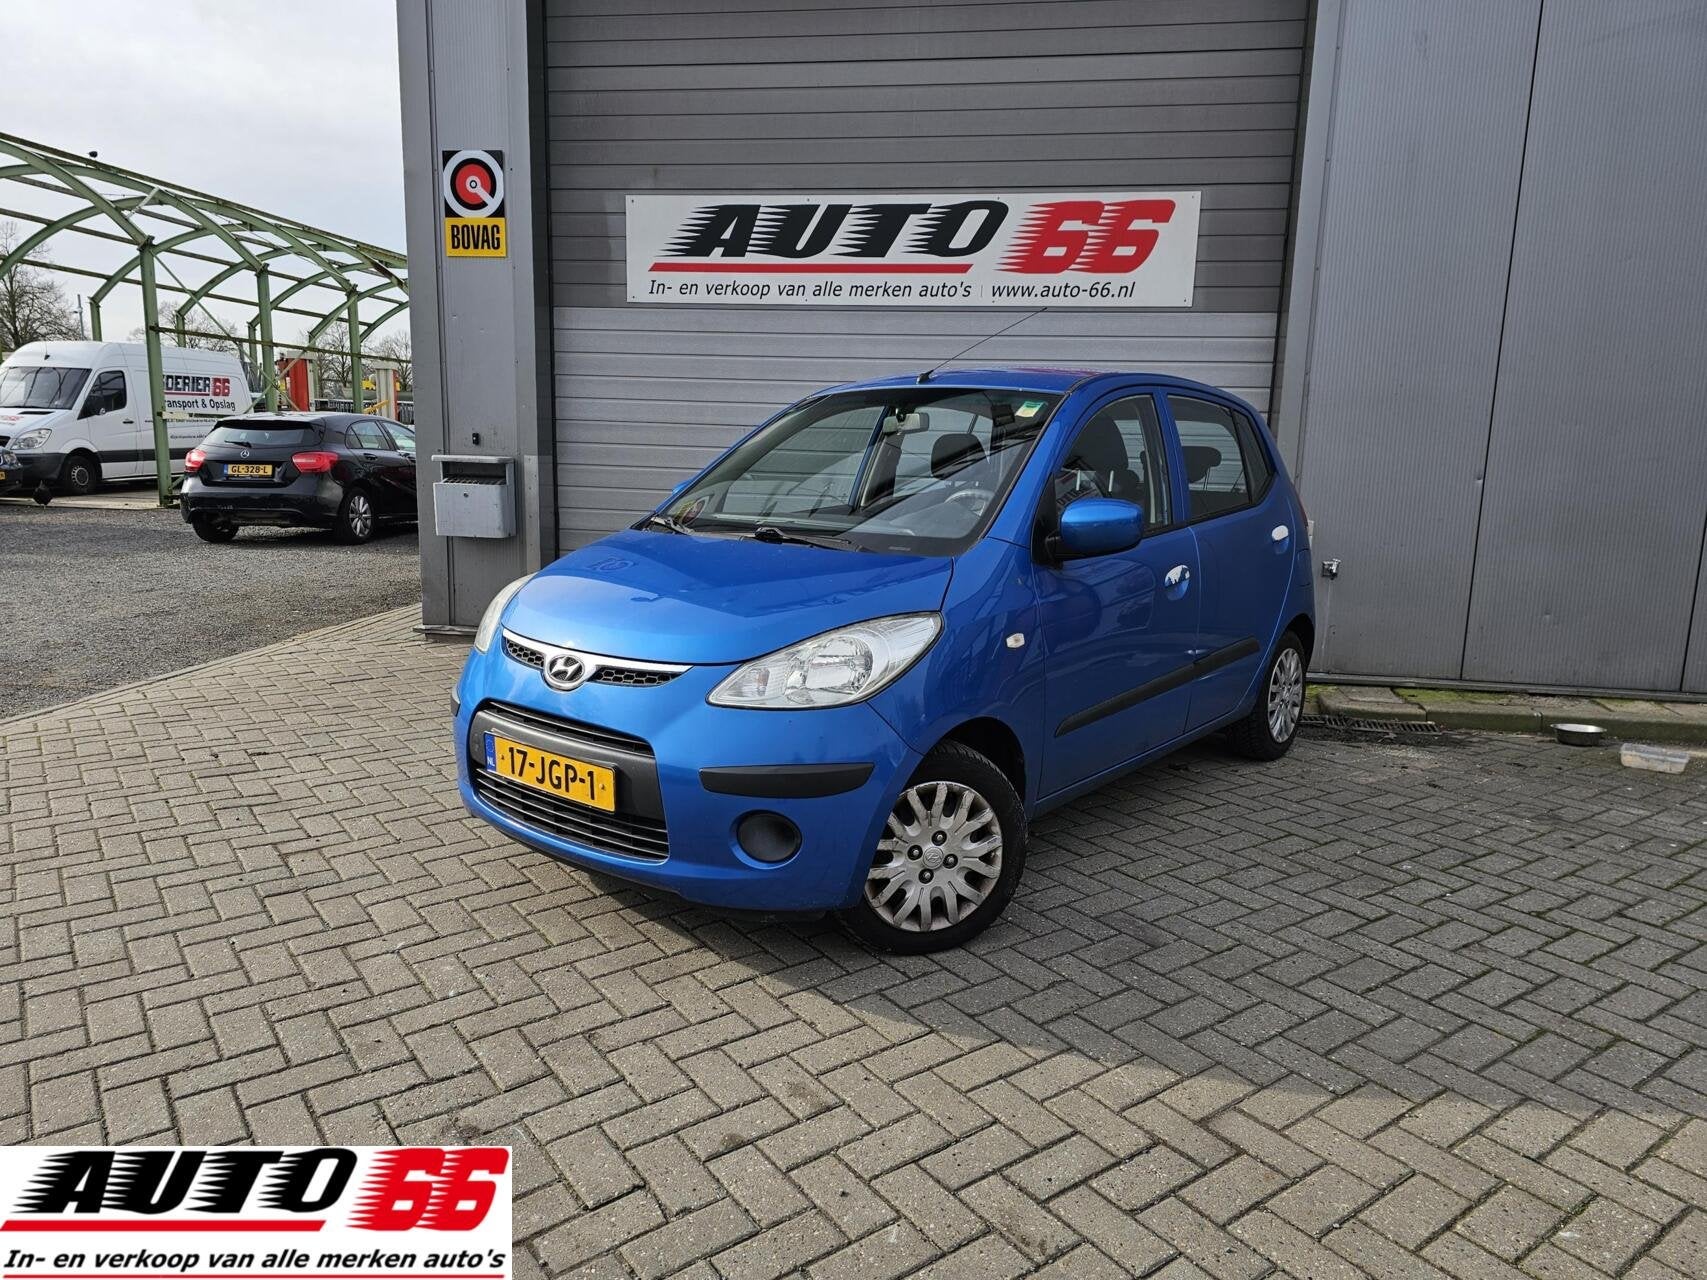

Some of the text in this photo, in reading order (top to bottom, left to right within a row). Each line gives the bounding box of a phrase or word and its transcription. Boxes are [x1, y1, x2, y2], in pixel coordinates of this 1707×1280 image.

[450, 224, 501, 250] BOVAG
[658, 199, 1176, 274] AUTO 66
[648, 279, 1136, 299] In- en verkoop van alle merken auto's www.auto-66.nl
[211, 377, 230, 396] 66
[201, 398, 208, 408] &
[209, 398, 236, 411] Opslag
[230, 464, 268, 474] GL-328-L
[508, 746, 594, 800] 17-JGP-1
